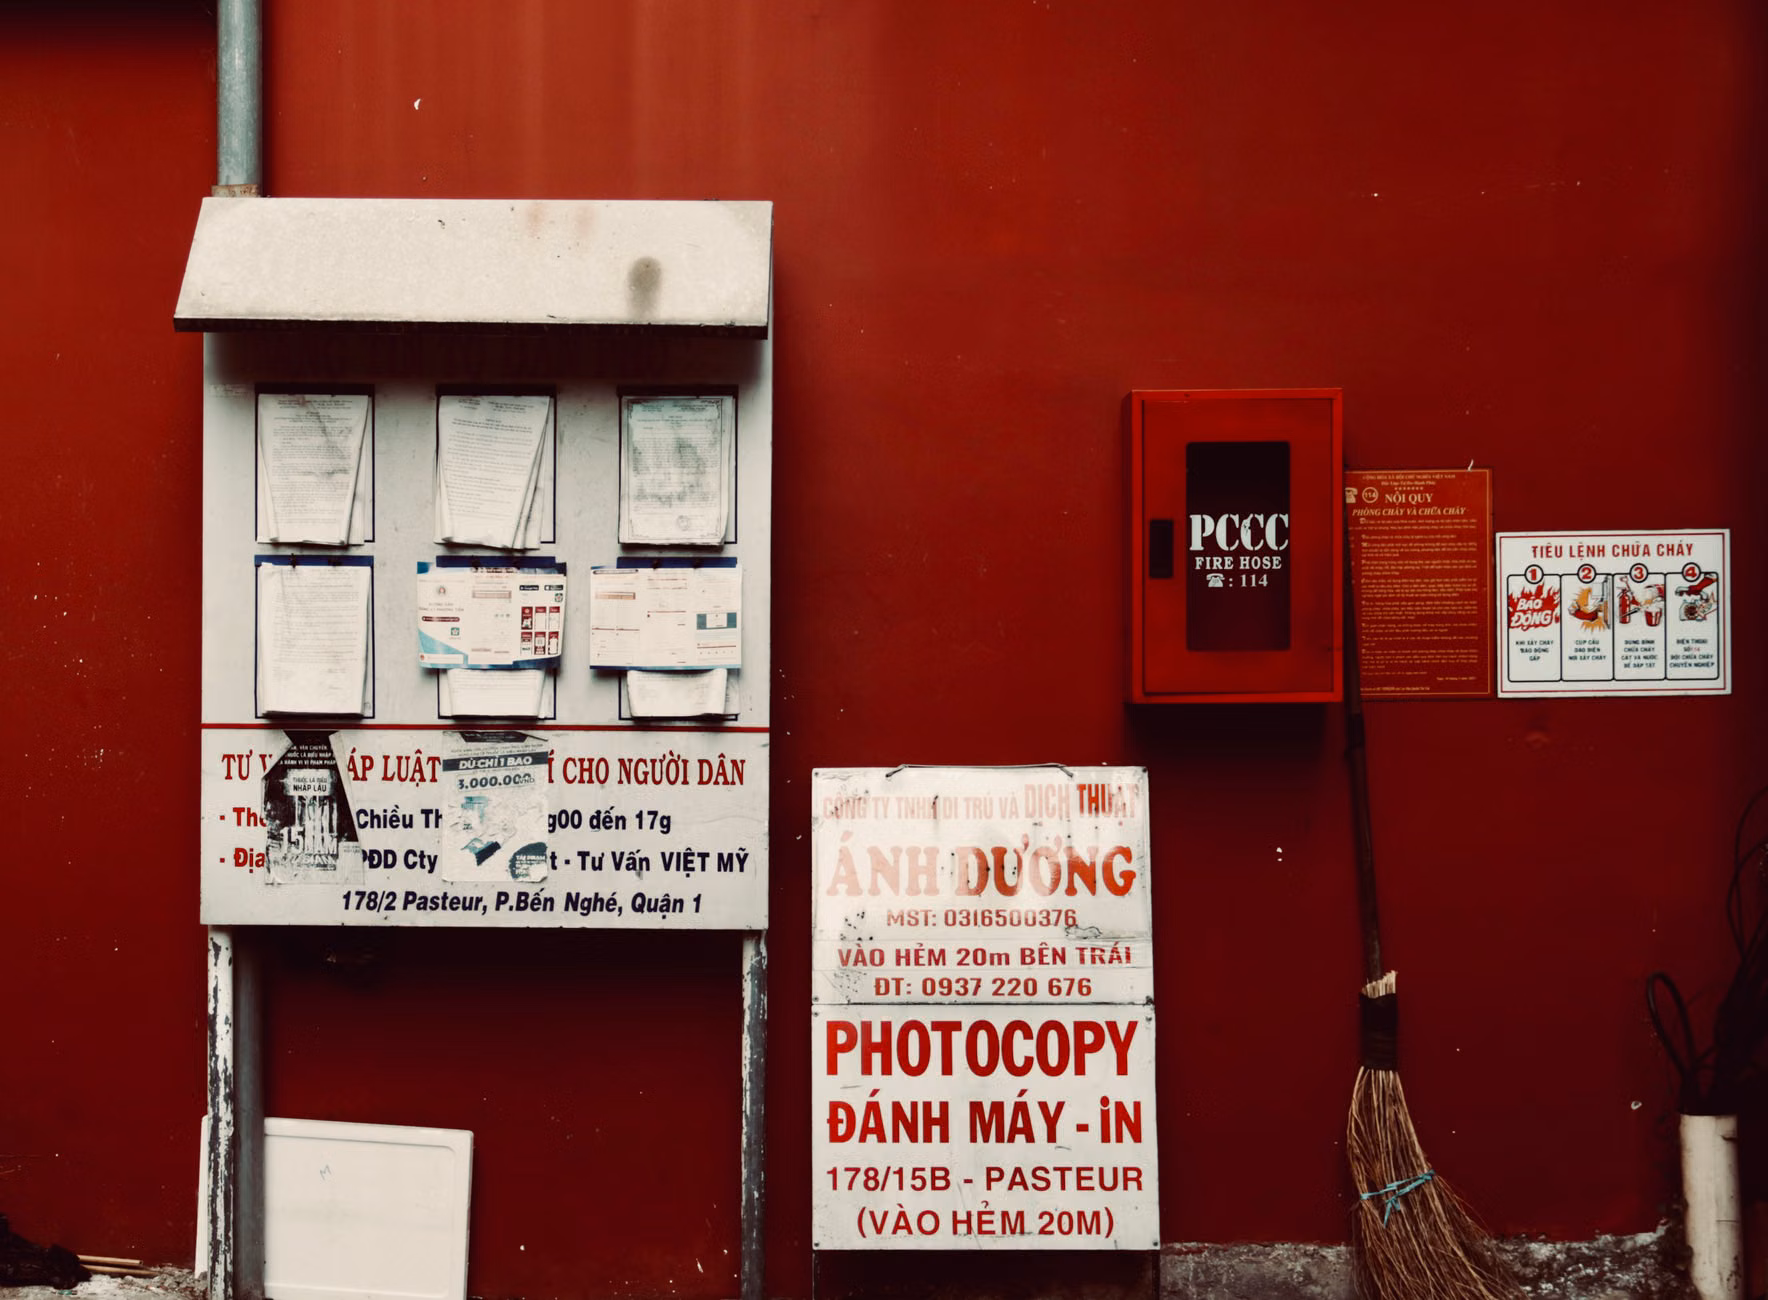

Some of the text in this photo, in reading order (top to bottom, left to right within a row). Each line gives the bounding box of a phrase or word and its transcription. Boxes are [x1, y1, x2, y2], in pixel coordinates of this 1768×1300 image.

[1384, 490, 1433, 505] NỘI QUY
[1352, 506, 1381, 516] PHÒNG
[1382, 506, 1404, 516] CHÁY
[1189, 513, 1289, 551] PCCC
[1656, 540, 1693, 556] CHÁY
[1195, 556, 1282, 570] FIRE HOSE
[1529, 566, 1697, 580] 1 2 3 4
[1241, 574, 1268, 587] 114
[1516, 596, 1543, 611] BÁO
[1510, 608, 1554, 630] ĐỘNG
[221, 748, 254, 781] TƯ
[381, 749, 441, 787] LUẬT
[562, 757, 609, 785] CHO
[617, 750, 690, 785] NGƯỜI
[697, 753, 746, 785] DÂN
[459, 757, 476, 769] DÙ
[507, 756, 533, 767] BAO
[356, 804, 413, 829] Chiều
[589, 806, 627, 831] đến
[635, 810, 671, 834] 17g
[823, 793, 868, 819] CÔNG
[871, 797, 890, 819] TY
[234, 847, 266, 874] Địa
[404, 850, 438, 874] Cty
[577, 851, 604, 871] Tư
[611, 849, 650, 871] Vấn
[661, 847, 710, 878] VIỆT
[717, 847, 749, 872] MỸ
[826, 830, 1137, 897] ÁNH DƯƠNG
[342, 888, 702, 919] 178/2 Pasteur, P.Bến Nghé, Quận 1
[886, 908, 1077, 928] MST: 0316500376
[838, 941, 1131, 967] VÀO HẺM 20m BÊN TRÁI
[874, 976, 1092, 997] ĐT: 0937 220 676
[826, 1019, 1139, 1077] PHOTOCOPY
[826, 1088, 950, 1144] ĐÁNH
[969, 1088, 1066, 1144] MÁY
[826, 1166, 951, 1192] 178/15B
[985, 1166, 1143, 1192] PASTEUR
[857, 1200, 1114, 1239] (VÀO HẺM 20M)
